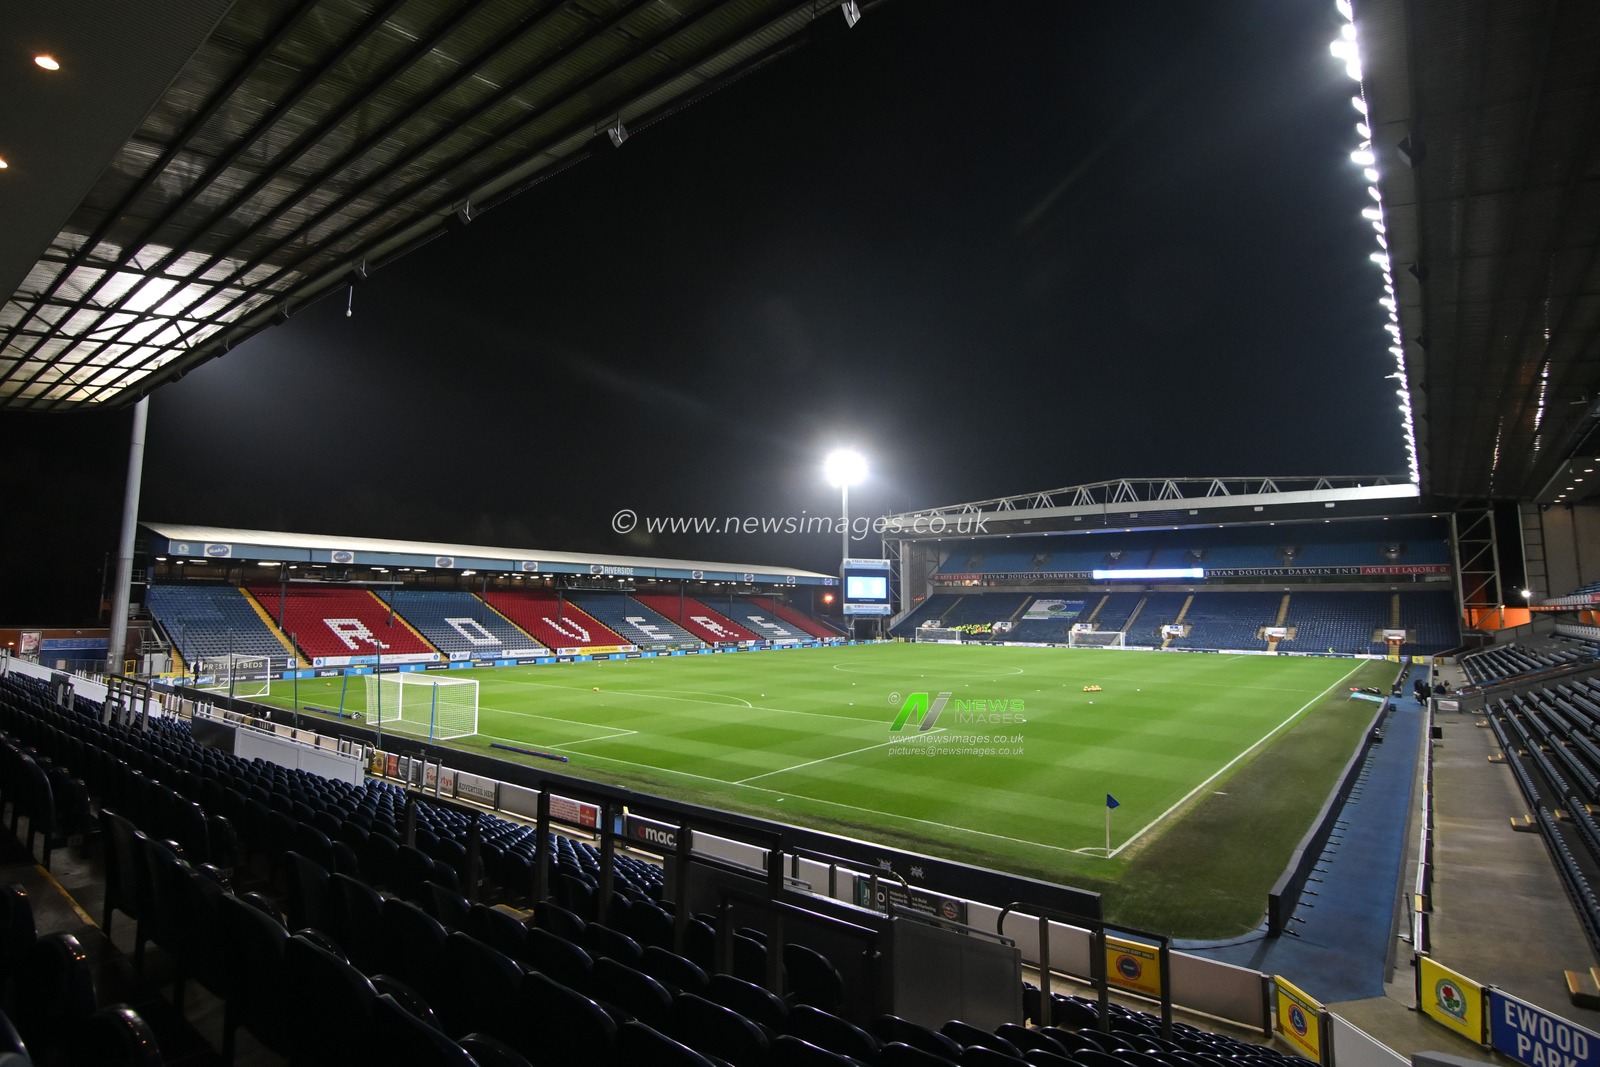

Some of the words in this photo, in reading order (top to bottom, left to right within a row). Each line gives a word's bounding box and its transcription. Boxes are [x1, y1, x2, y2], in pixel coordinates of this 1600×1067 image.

[605, 566, 634, 575] RIVERSIDE
[243, 661, 263, 669] BEDS
[426, 771, 452, 787] Fogrtys
[458, 782, 483, 796] ADVERTISE
[1105, 943, 1130, 953] MERGENCY
[1504, 1000, 1589, 1061] EWOOD
[1516, 1032, 1578, 1067] PARK
